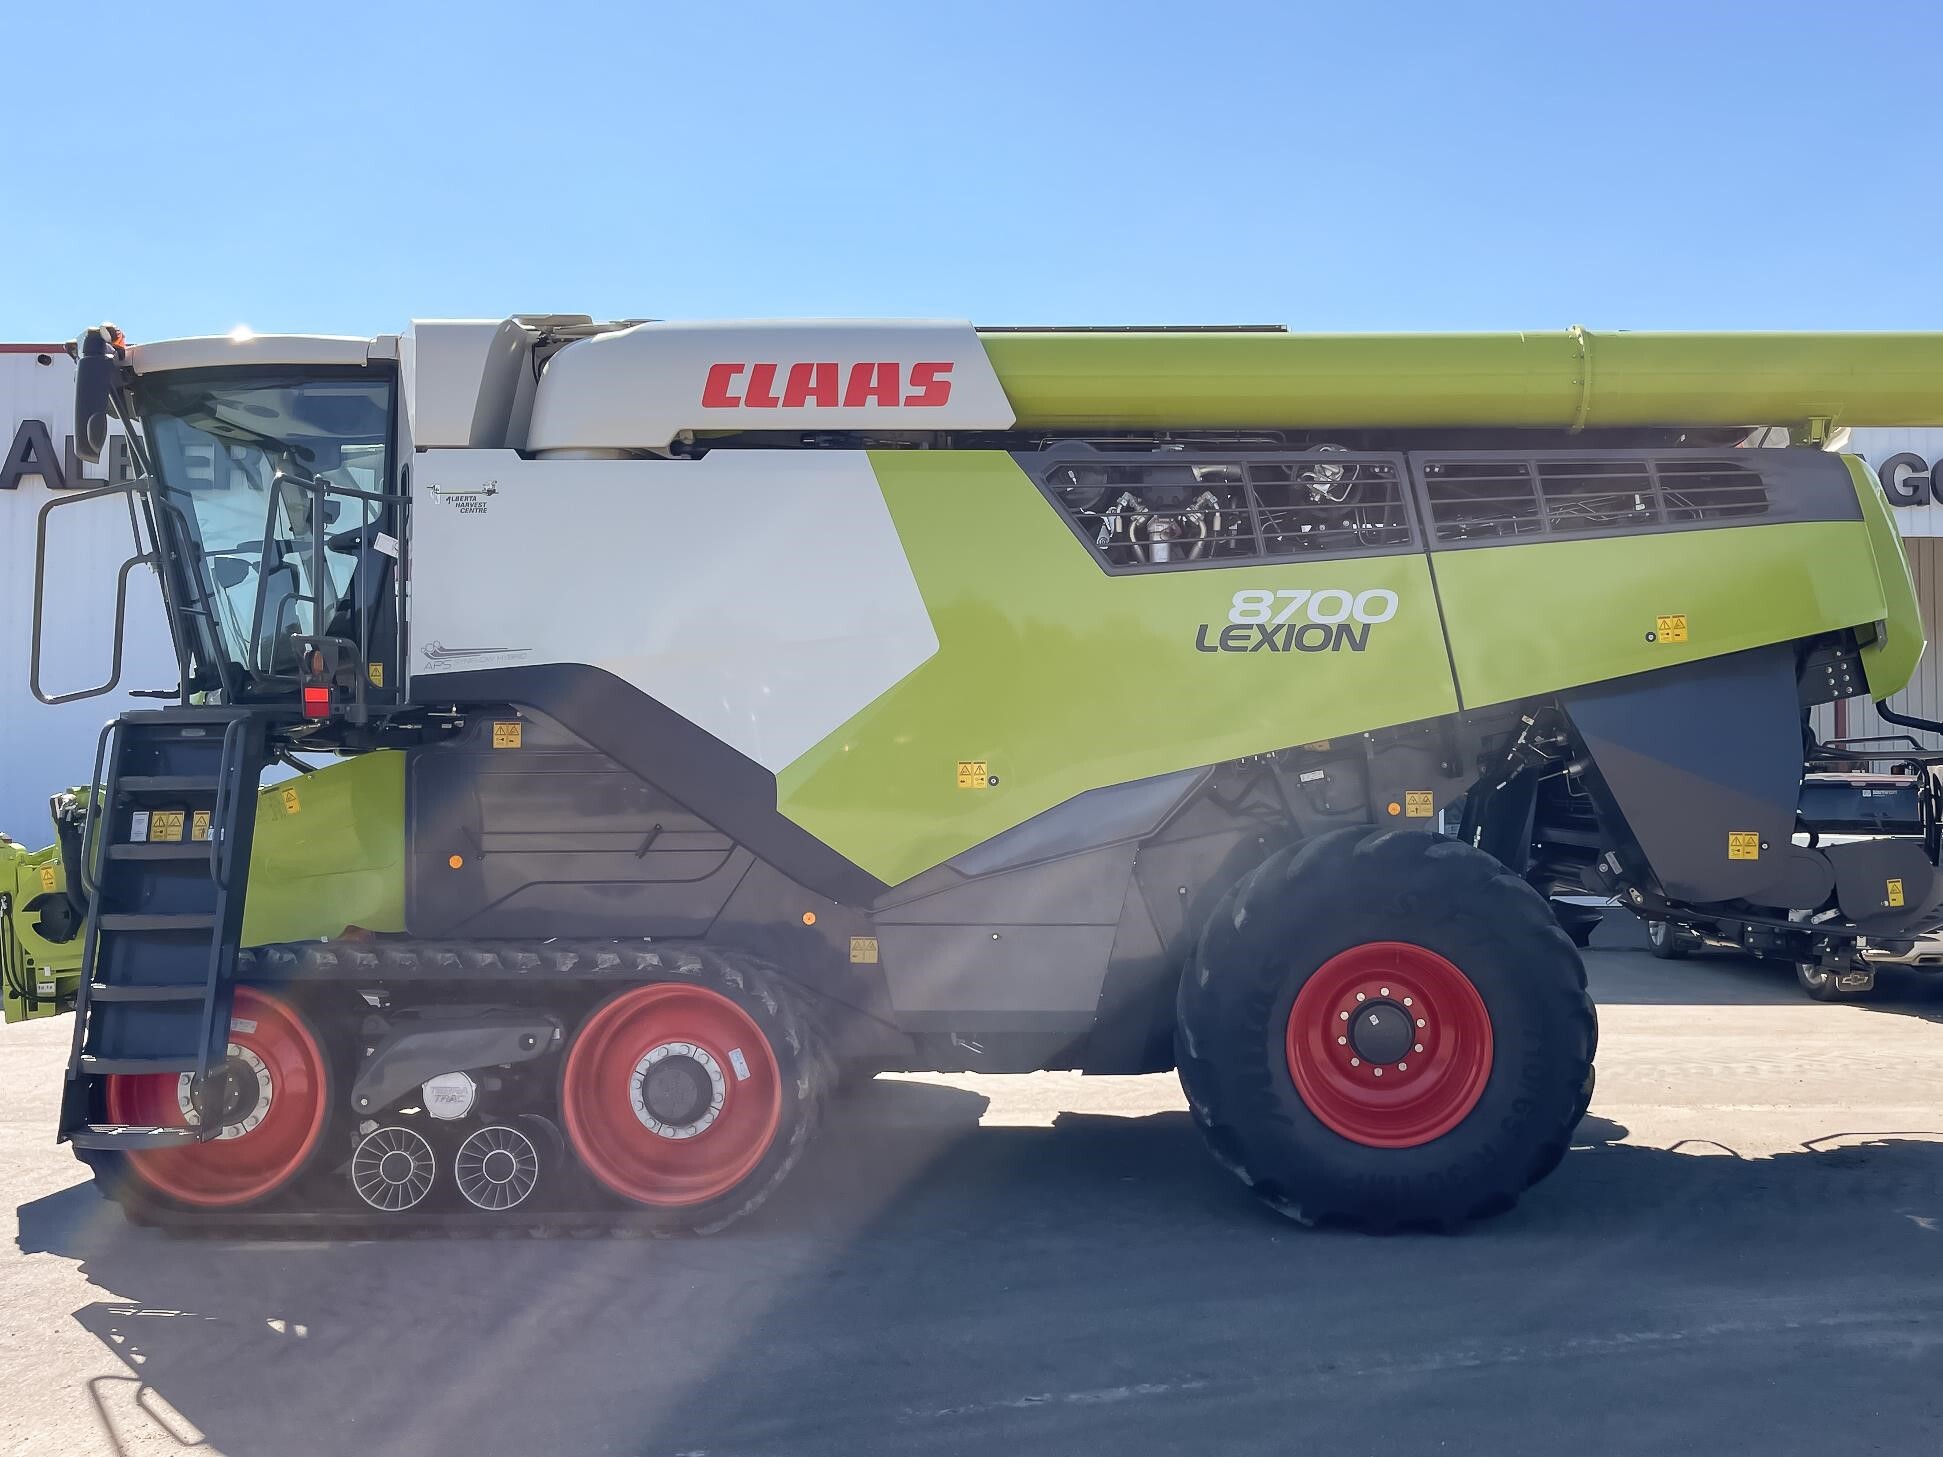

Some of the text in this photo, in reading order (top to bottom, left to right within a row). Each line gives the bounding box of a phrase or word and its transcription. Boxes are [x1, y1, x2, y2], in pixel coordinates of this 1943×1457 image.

[701, 362, 955, 408] CLAAS
[446, 495, 477, 504] ALBERTA
[1228, 588, 1399, 625] 8700
[1195, 623, 1371, 652] LEXION
[424, 660, 452, 671] APS
[434, 1095, 466, 1103] TRAC
